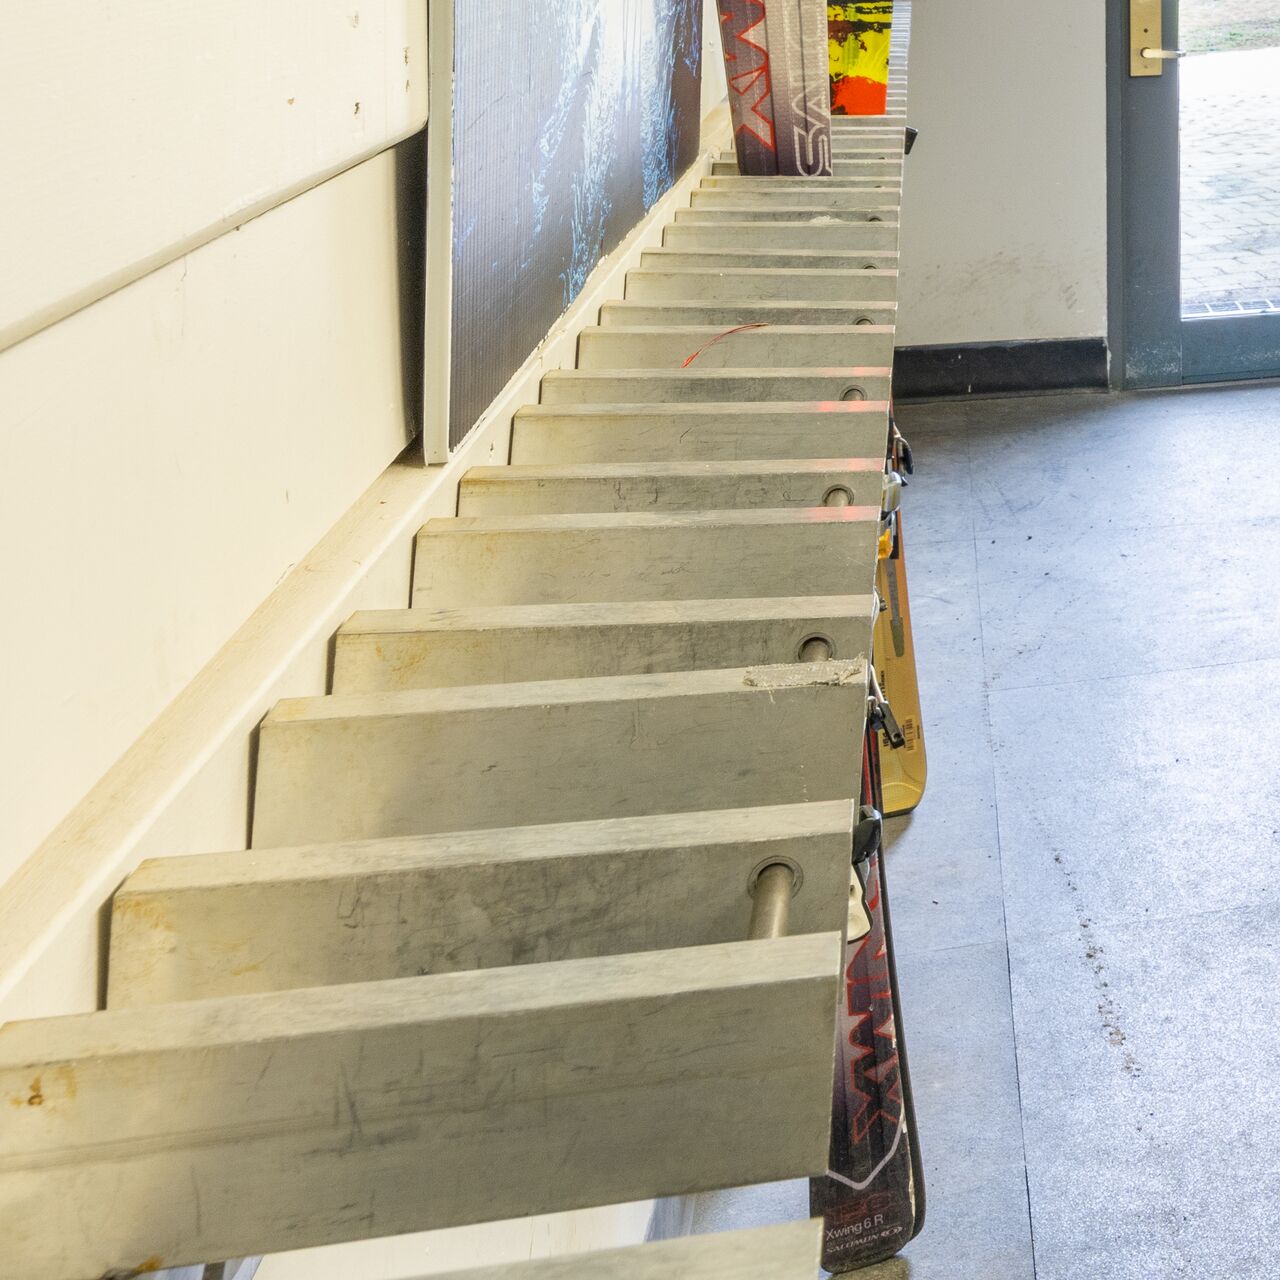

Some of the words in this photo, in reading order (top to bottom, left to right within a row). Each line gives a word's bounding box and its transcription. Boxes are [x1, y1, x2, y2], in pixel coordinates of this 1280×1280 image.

[846, 870, 900, 1145] XWIN
[826, 1222, 862, 1241] Xwing
[863, 1216, 872, 1229] 6
[874, 1214, 884, 1226] R
